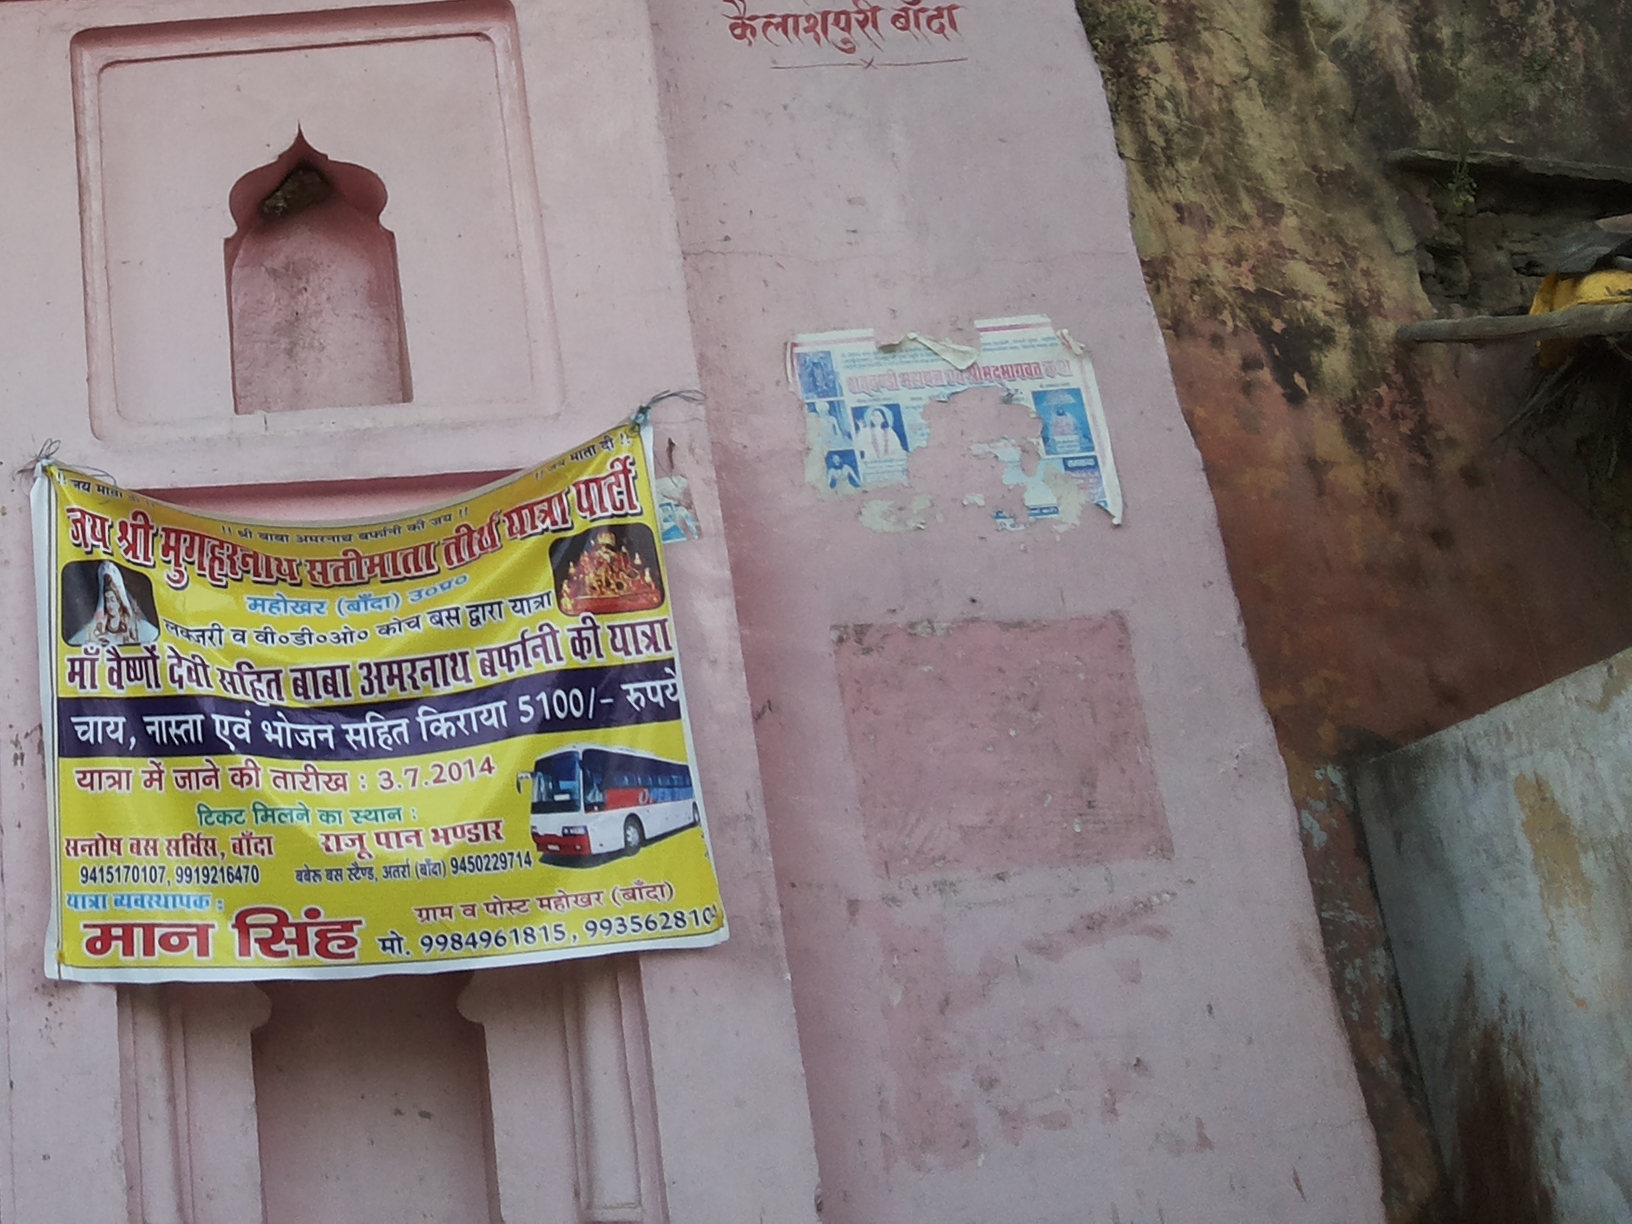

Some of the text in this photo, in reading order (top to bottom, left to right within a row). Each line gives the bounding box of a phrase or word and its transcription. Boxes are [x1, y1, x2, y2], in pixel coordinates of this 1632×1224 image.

[569, 444, 598, 462] माता
[599, 434, 615, 451] दी
[66, 506, 112, 554] जय
[117, 509, 156, 566] श्री
[443, 510, 505, 570] तीर्थ
[502, 489, 574, 541] यात्रा
[573, 455, 642, 520] पार्टी
[406, 518, 426, 533] की
[430, 513, 453, 528] जय
[232, 629, 247, 645] व
[375, 616, 422, 638] कोच
[426, 606, 460, 628] बस
[466, 599, 505, 626] द्वारा
[509, 590, 555, 616] यात्रा
[246, 593, 329, 616] महोखर
[337, 590, 401, 618] (बाँदा)
[67, 645, 98, 691] माँ
[167, 645, 214, 690] देवी
[216, 659, 285, 707] सहित
[289, 663, 352, 702] बाबा
[358, 650, 473, 698] अमरनाथ
[477, 622, 564, 679] बर्फानी
[568, 614, 605, 662] की
[607, 617, 675, 654] यात्रा
[70, 715, 137, 751] चाय,
[143, 713, 205, 746] नास्ता
[210, 709, 252, 752] एवं
[262, 710, 336, 751] भोजन
[340, 712, 410, 752] सहित
[417, 699, 511, 744] किराया
[518, 686, 615, 724] 5100/-
[75, 767, 132, 793] यात्रा
[141, 760, 166, 792] में
[172, 759, 220, 792] जाने
[228, 758, 262, 790] की
[270, 763, 349, 793] तारीख
[378, 755, 496, 791] 3.7.2014
[196, 803, 247, 828] टिकट
[252, 800, 311, 827] मिलने
[317, 809, 343, 825] का
[351, 806, 404, 826] स्थान
[64, 832, 123, 858] सन्तोष
[129, 837, 159, 857] बस
[229, 831, 276, 857] बाँदा
[319, 818, 505, 860] राजू पान भण्डार
[80, 864, 261, 887] 9415170107, 9919216470
[325, 867, 344, 882] बस
[450, 850, 532, 875] 9450229714
[66, 892, 108, 911] यात्रा
[112, 892, 211, 911] व्यवस्थापक
[413, 878, 676, 924] ग्राम व पोस्ट महोखर (बाँदा)
[82, 906, 364, 960] मान सिंह
[378, 929, 411, 957] मो.
